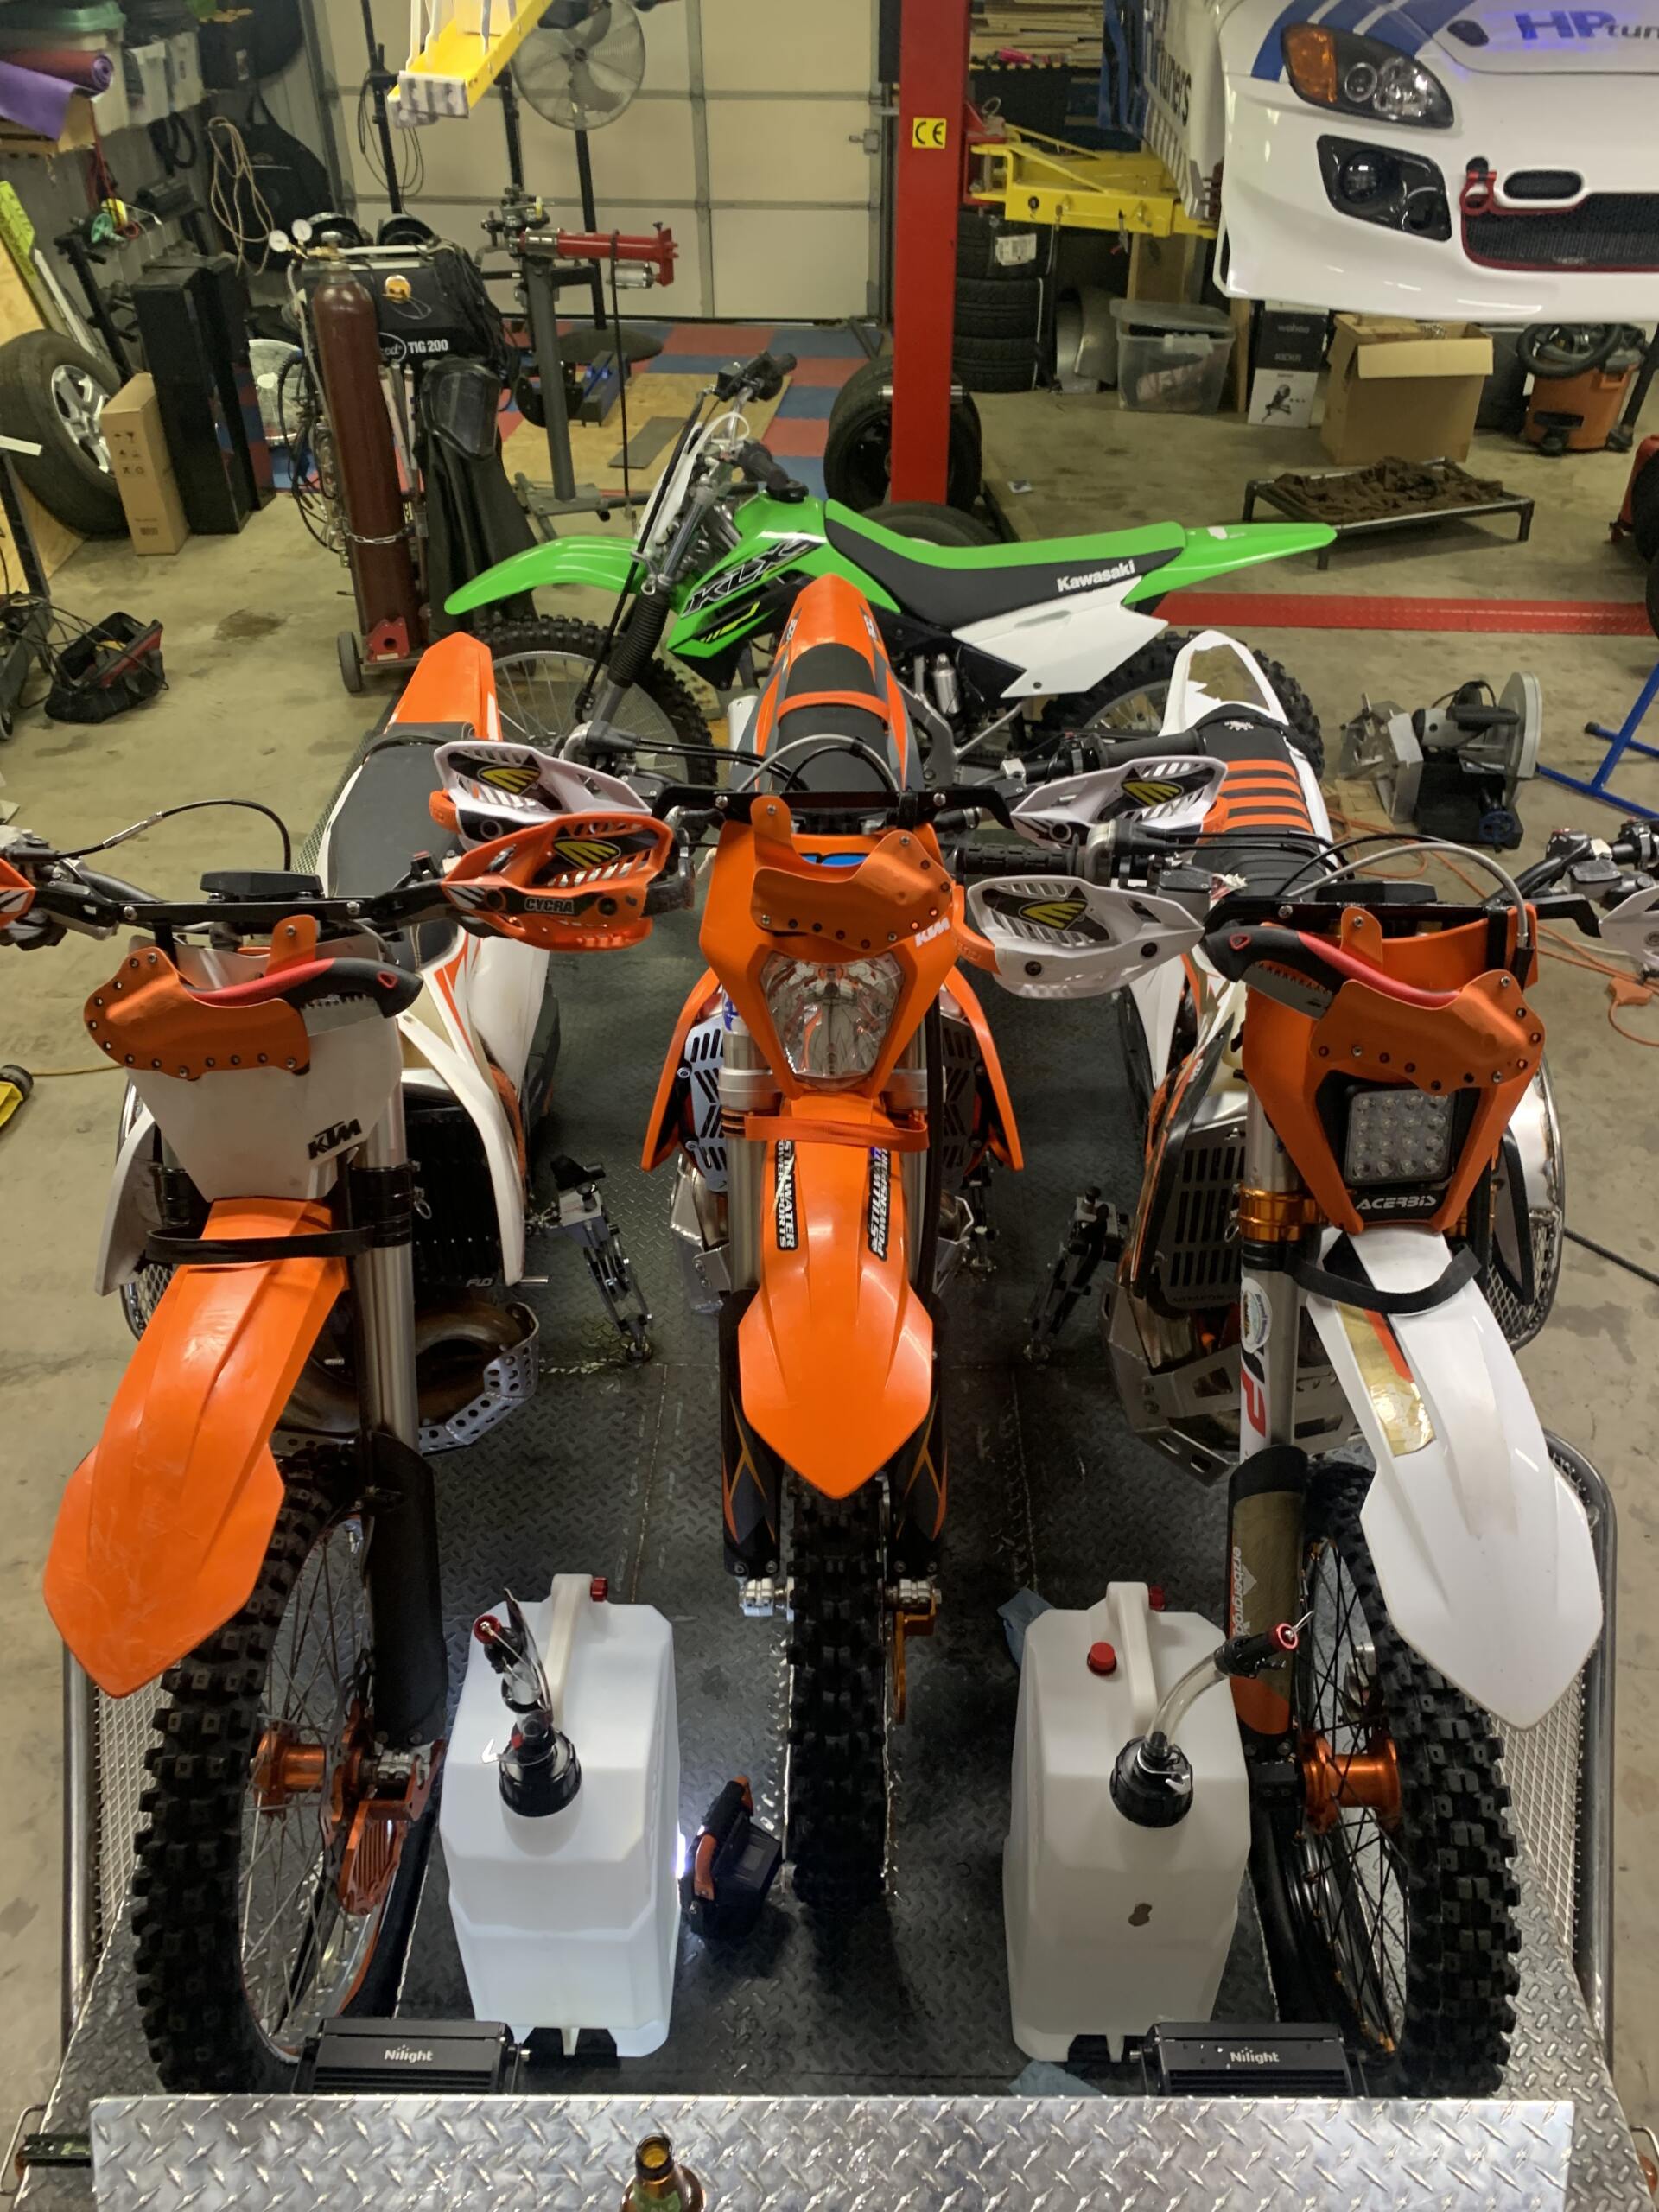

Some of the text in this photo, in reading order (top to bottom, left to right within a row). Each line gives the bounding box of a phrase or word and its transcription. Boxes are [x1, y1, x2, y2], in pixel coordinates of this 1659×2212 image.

[915, 121, 944, 146] CE
[407, 340, 427, 354] TIG
[427, 339, 448, 353] 200
[680, 537, 812, 619] KLX
[1056, 559, 1135, 592] Kawasaki
[524, 896, 575, 915] CYCRA
[914, 917, 950, 948] KTM
[308, 1118, 362, 1160] KTM
[384, 2044, 433, 2063] Nilight
[1230, 2046, 1280, 2064] Nilight
